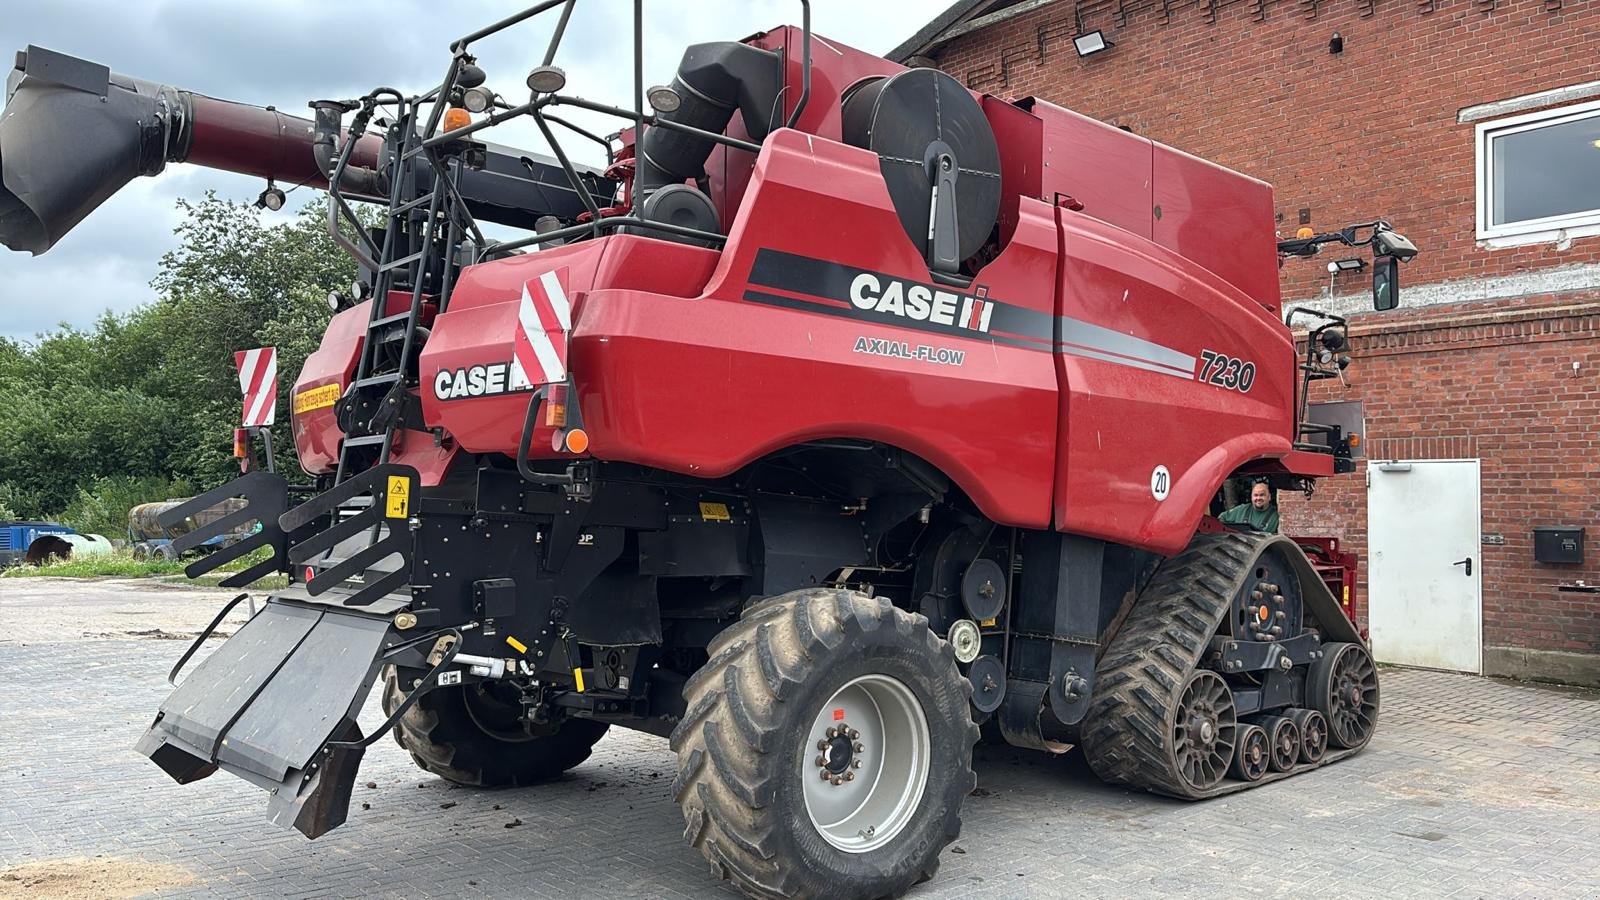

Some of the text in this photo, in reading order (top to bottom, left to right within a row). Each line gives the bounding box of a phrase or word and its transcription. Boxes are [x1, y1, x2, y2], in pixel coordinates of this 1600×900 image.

[850, 273, 958, 326] CASE
[853, 336, 965, 366] AXIAL-FLOW
[434, 364, 506, 400] CASE
[1199, 349, 1256, 393] 7230
[1155, 471, 1167, 494] 20
